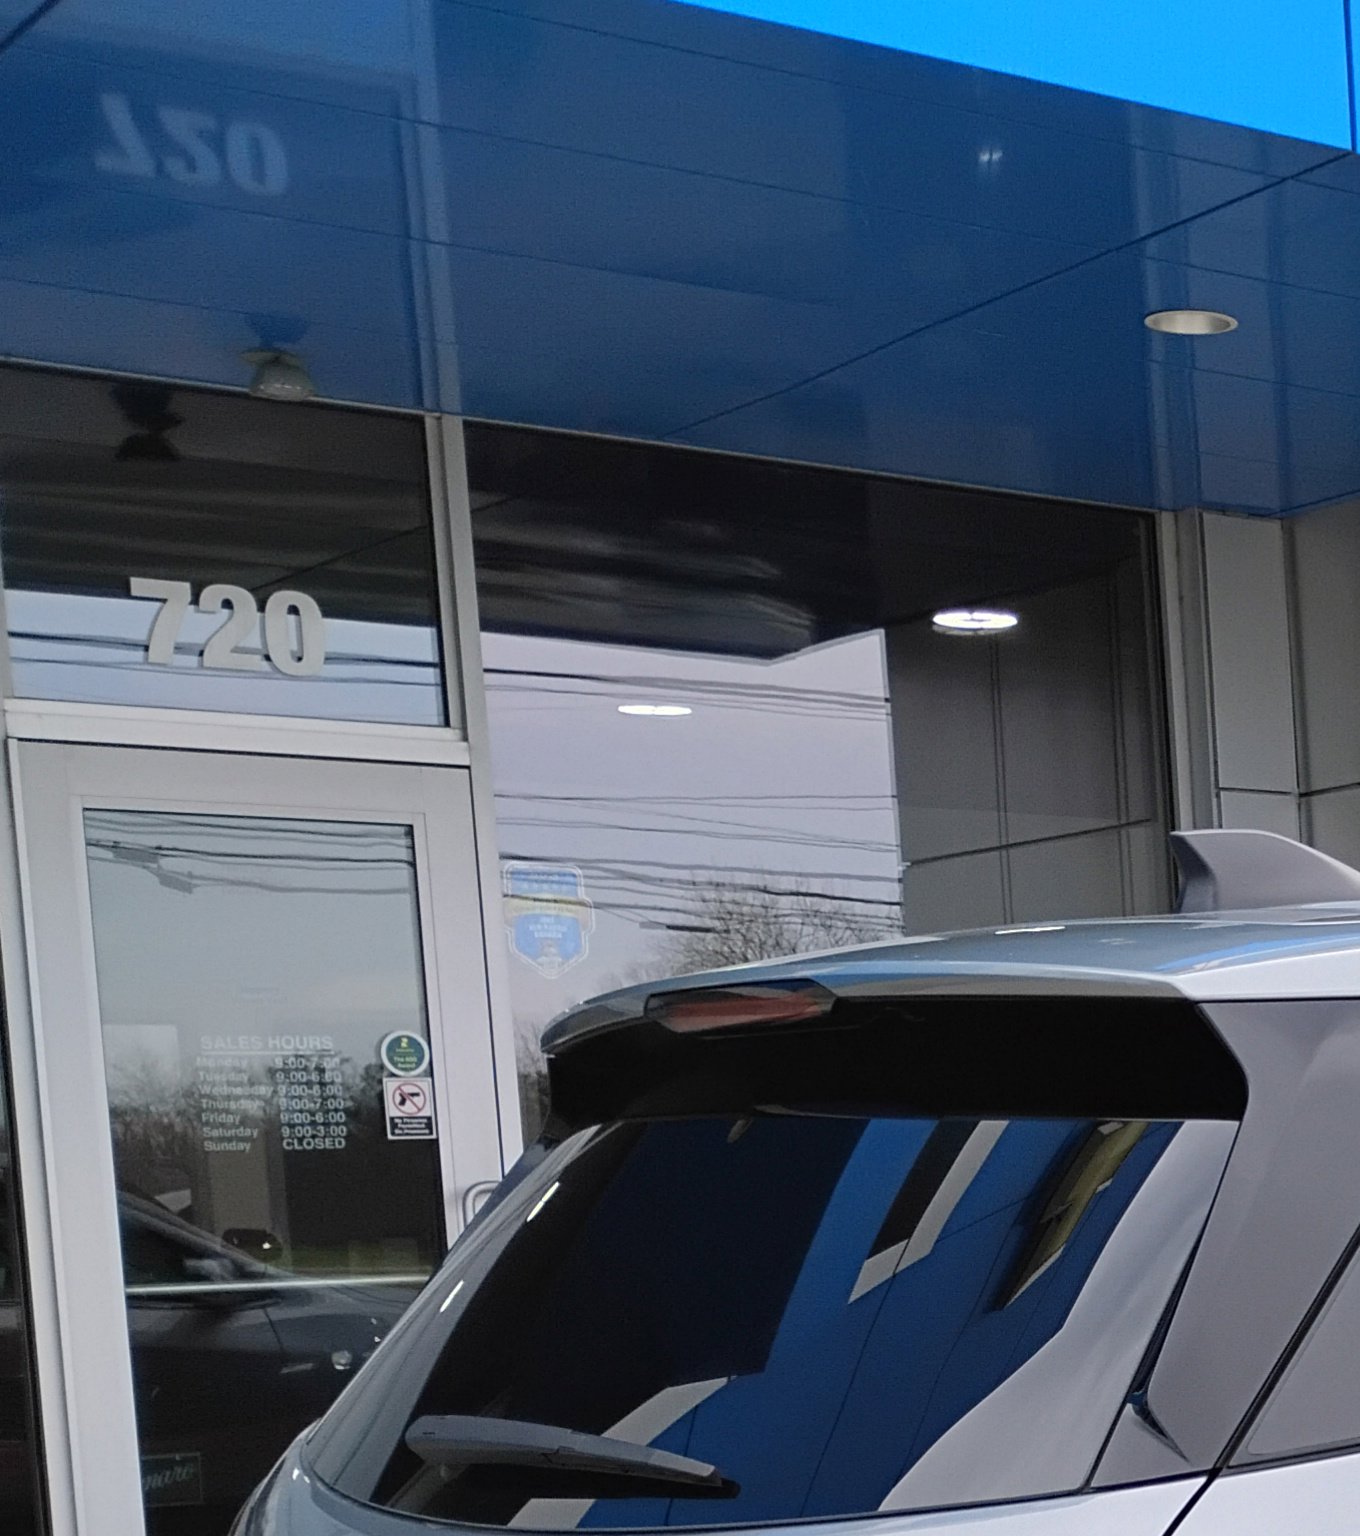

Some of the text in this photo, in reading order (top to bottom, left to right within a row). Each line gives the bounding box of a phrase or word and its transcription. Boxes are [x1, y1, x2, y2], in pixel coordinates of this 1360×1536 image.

[130, 577, 325, 676] 720
[200, 1035, 334, 1050] SALES HOURS
[199, 1084, 274, 1097] Wednesday
[200, 1099, 258, 1112] Thursday
[201, 1111, 346, 1126] Friday 9:00-6:00
[202, 1125, 347, 1139] Saturday 9:00-3:00
[204, 1138, 346, 1153] Sunday CLOSED
